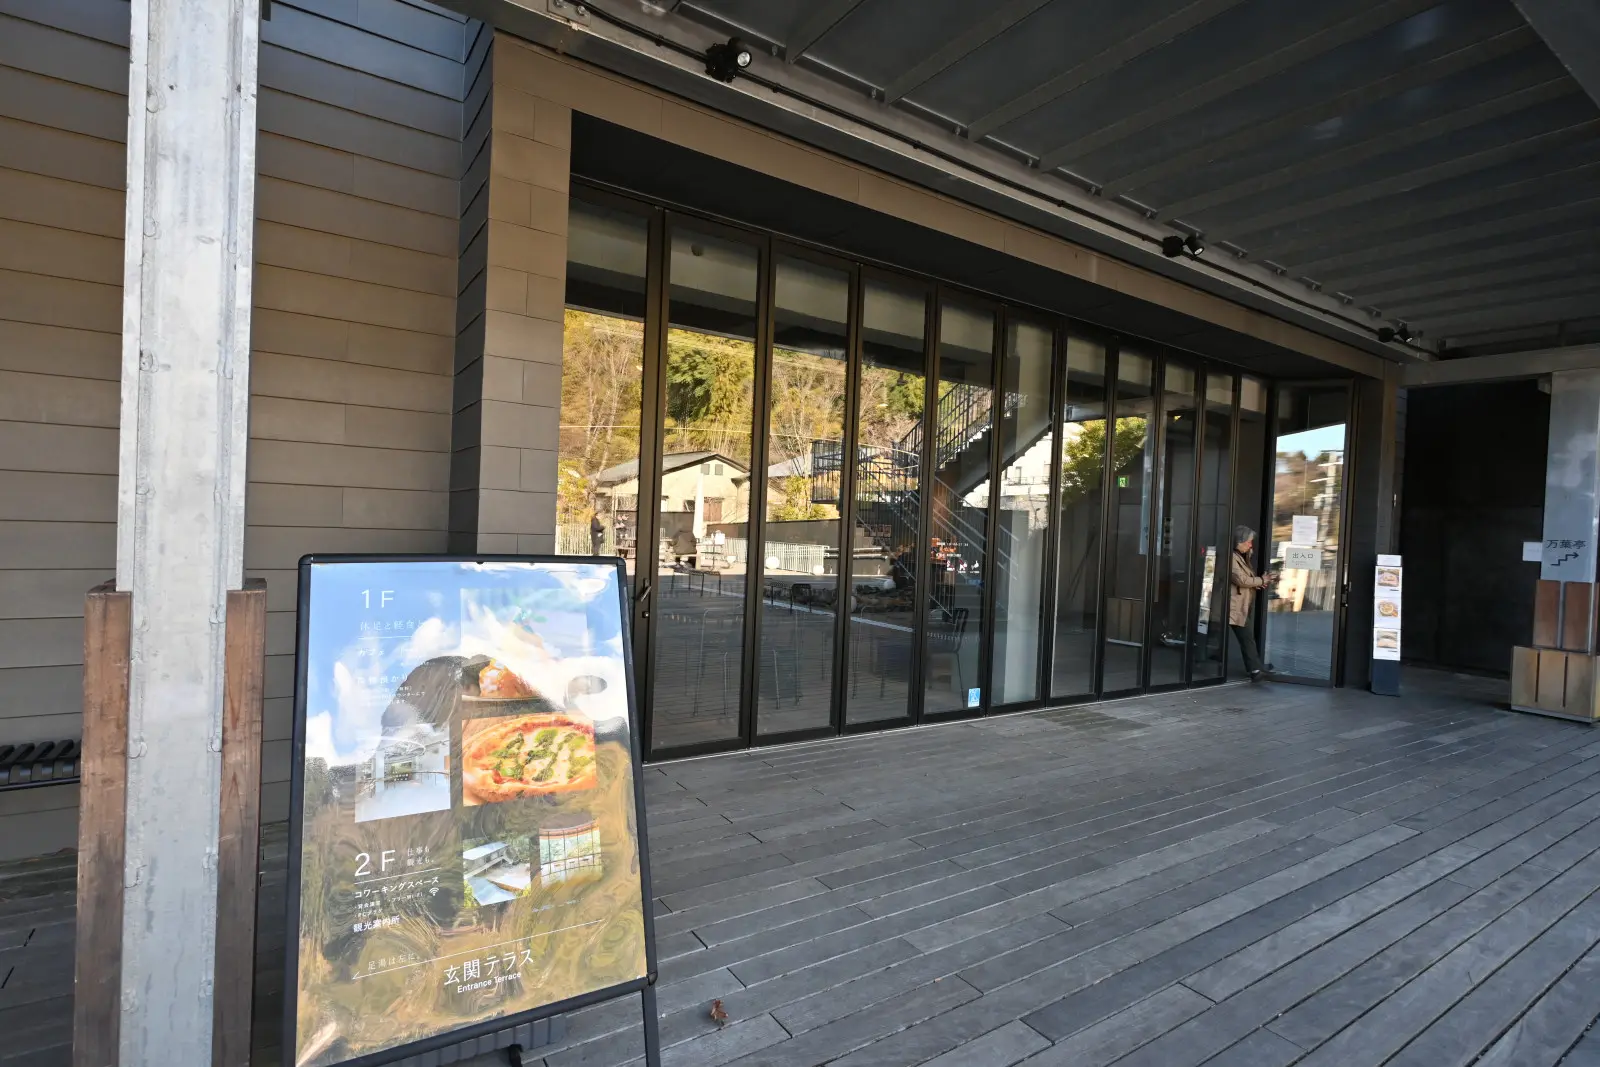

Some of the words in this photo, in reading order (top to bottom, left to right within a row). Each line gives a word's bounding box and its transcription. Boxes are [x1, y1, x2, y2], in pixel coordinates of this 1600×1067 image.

[1546, 539, 1586, 549] 万葉亭
[354, 876, 440, 899] コワーキングスペース
[353, 914, 401, 933] 観光案内所
[443, 949, 534, 986] 玄関テラス
[457, 979, 492, 994] Entrance
[493, 971, 522, 986] Terrace
